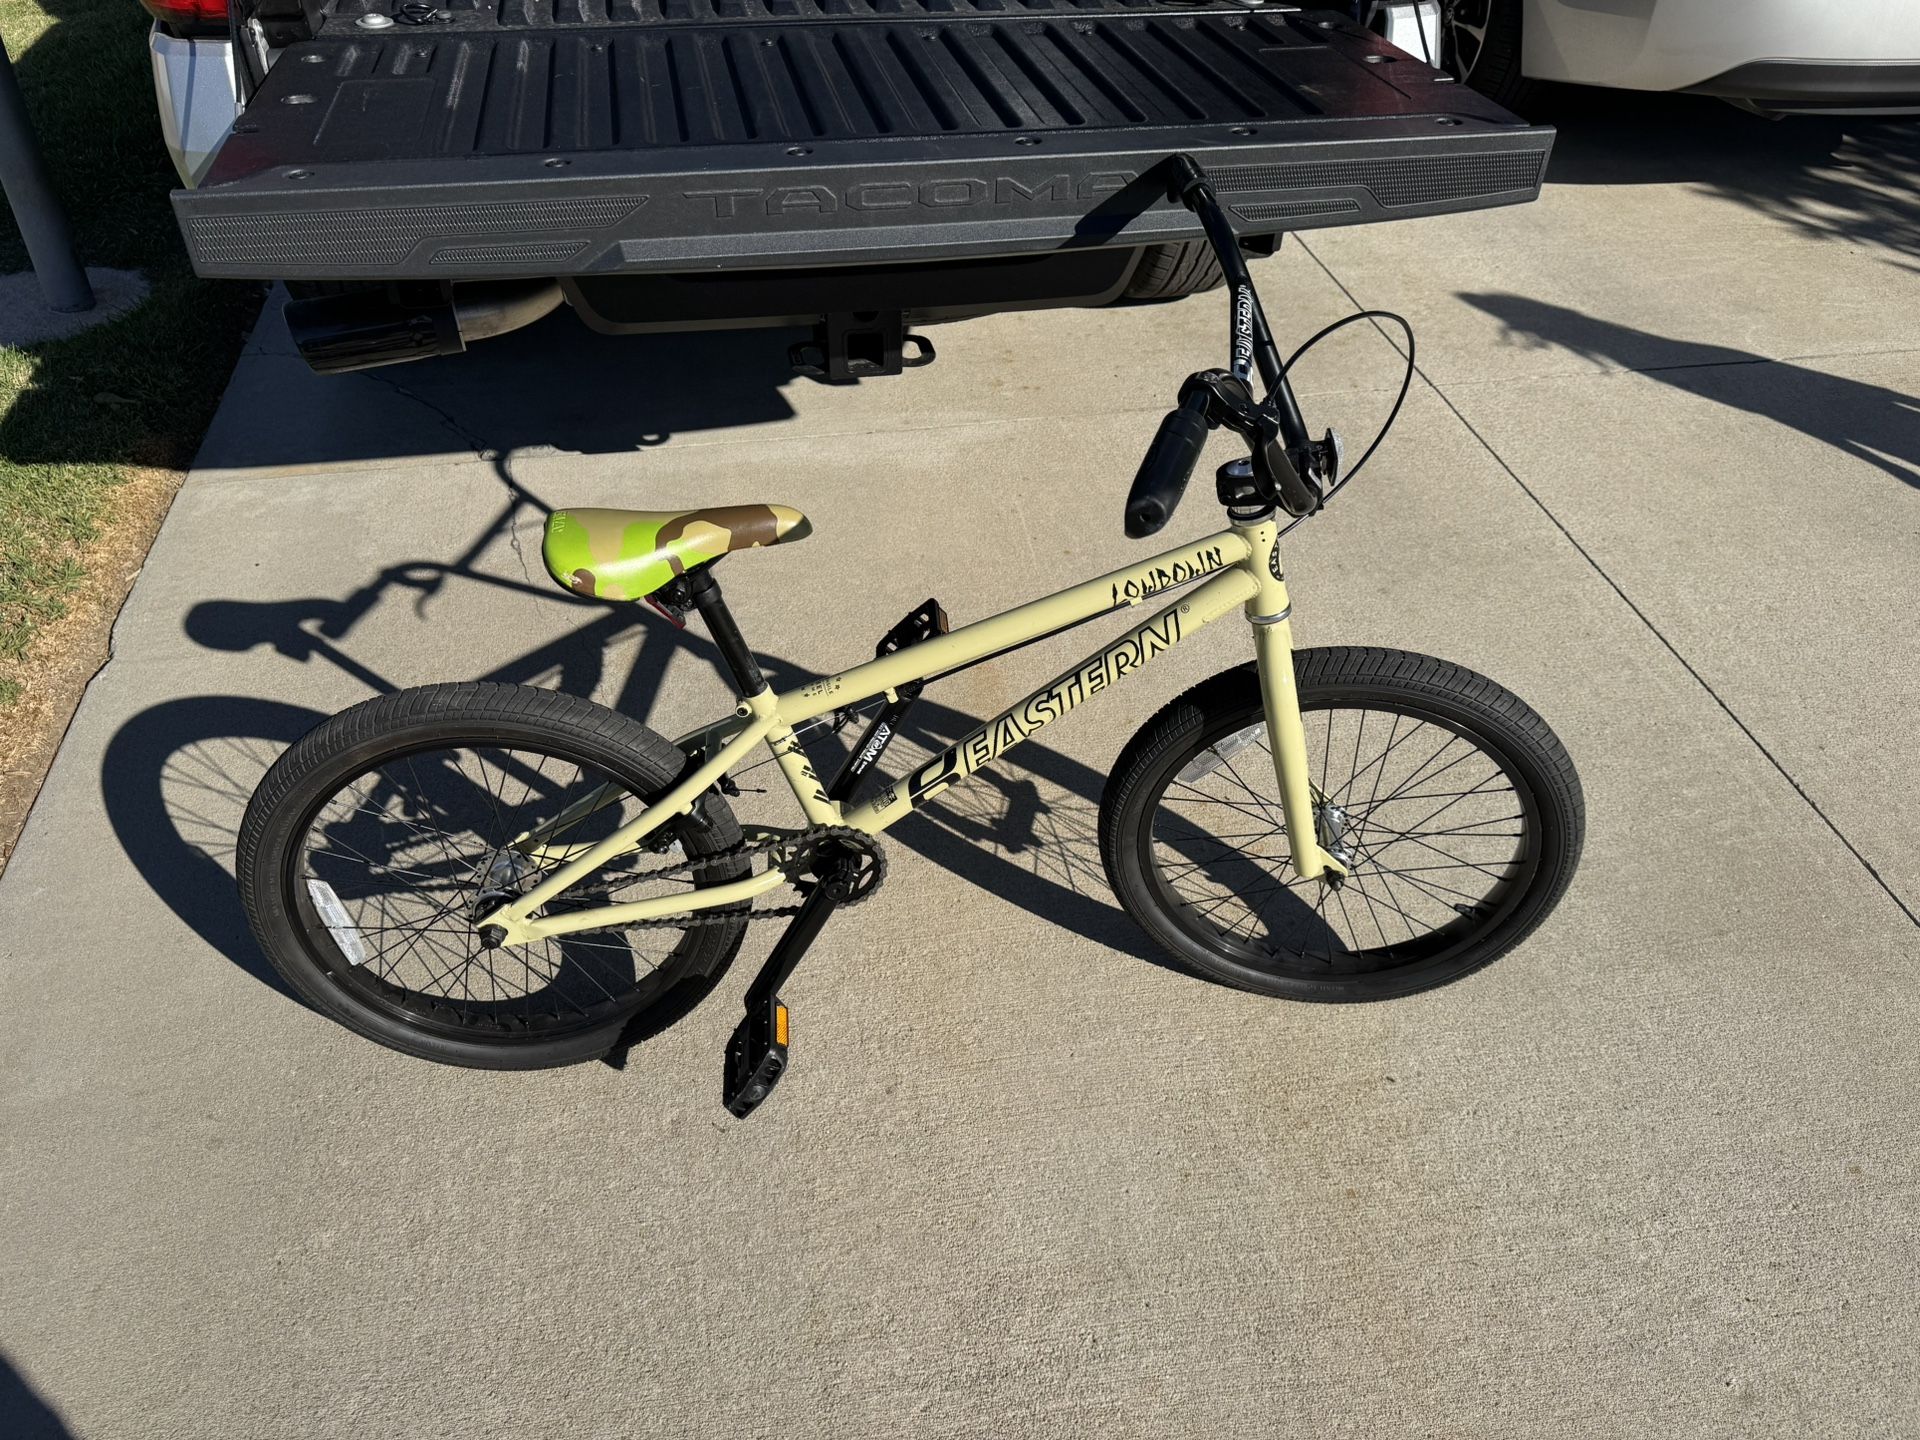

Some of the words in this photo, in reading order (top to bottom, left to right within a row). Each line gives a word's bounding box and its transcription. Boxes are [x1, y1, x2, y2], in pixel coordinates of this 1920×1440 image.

[683, 170, 1142, 218] TACOMA
[1112, 546, 1223, 606] LOWDOWN
[962, 608, 1181, 774] EASTERN
[863, 725, 891, 762] ATOM
